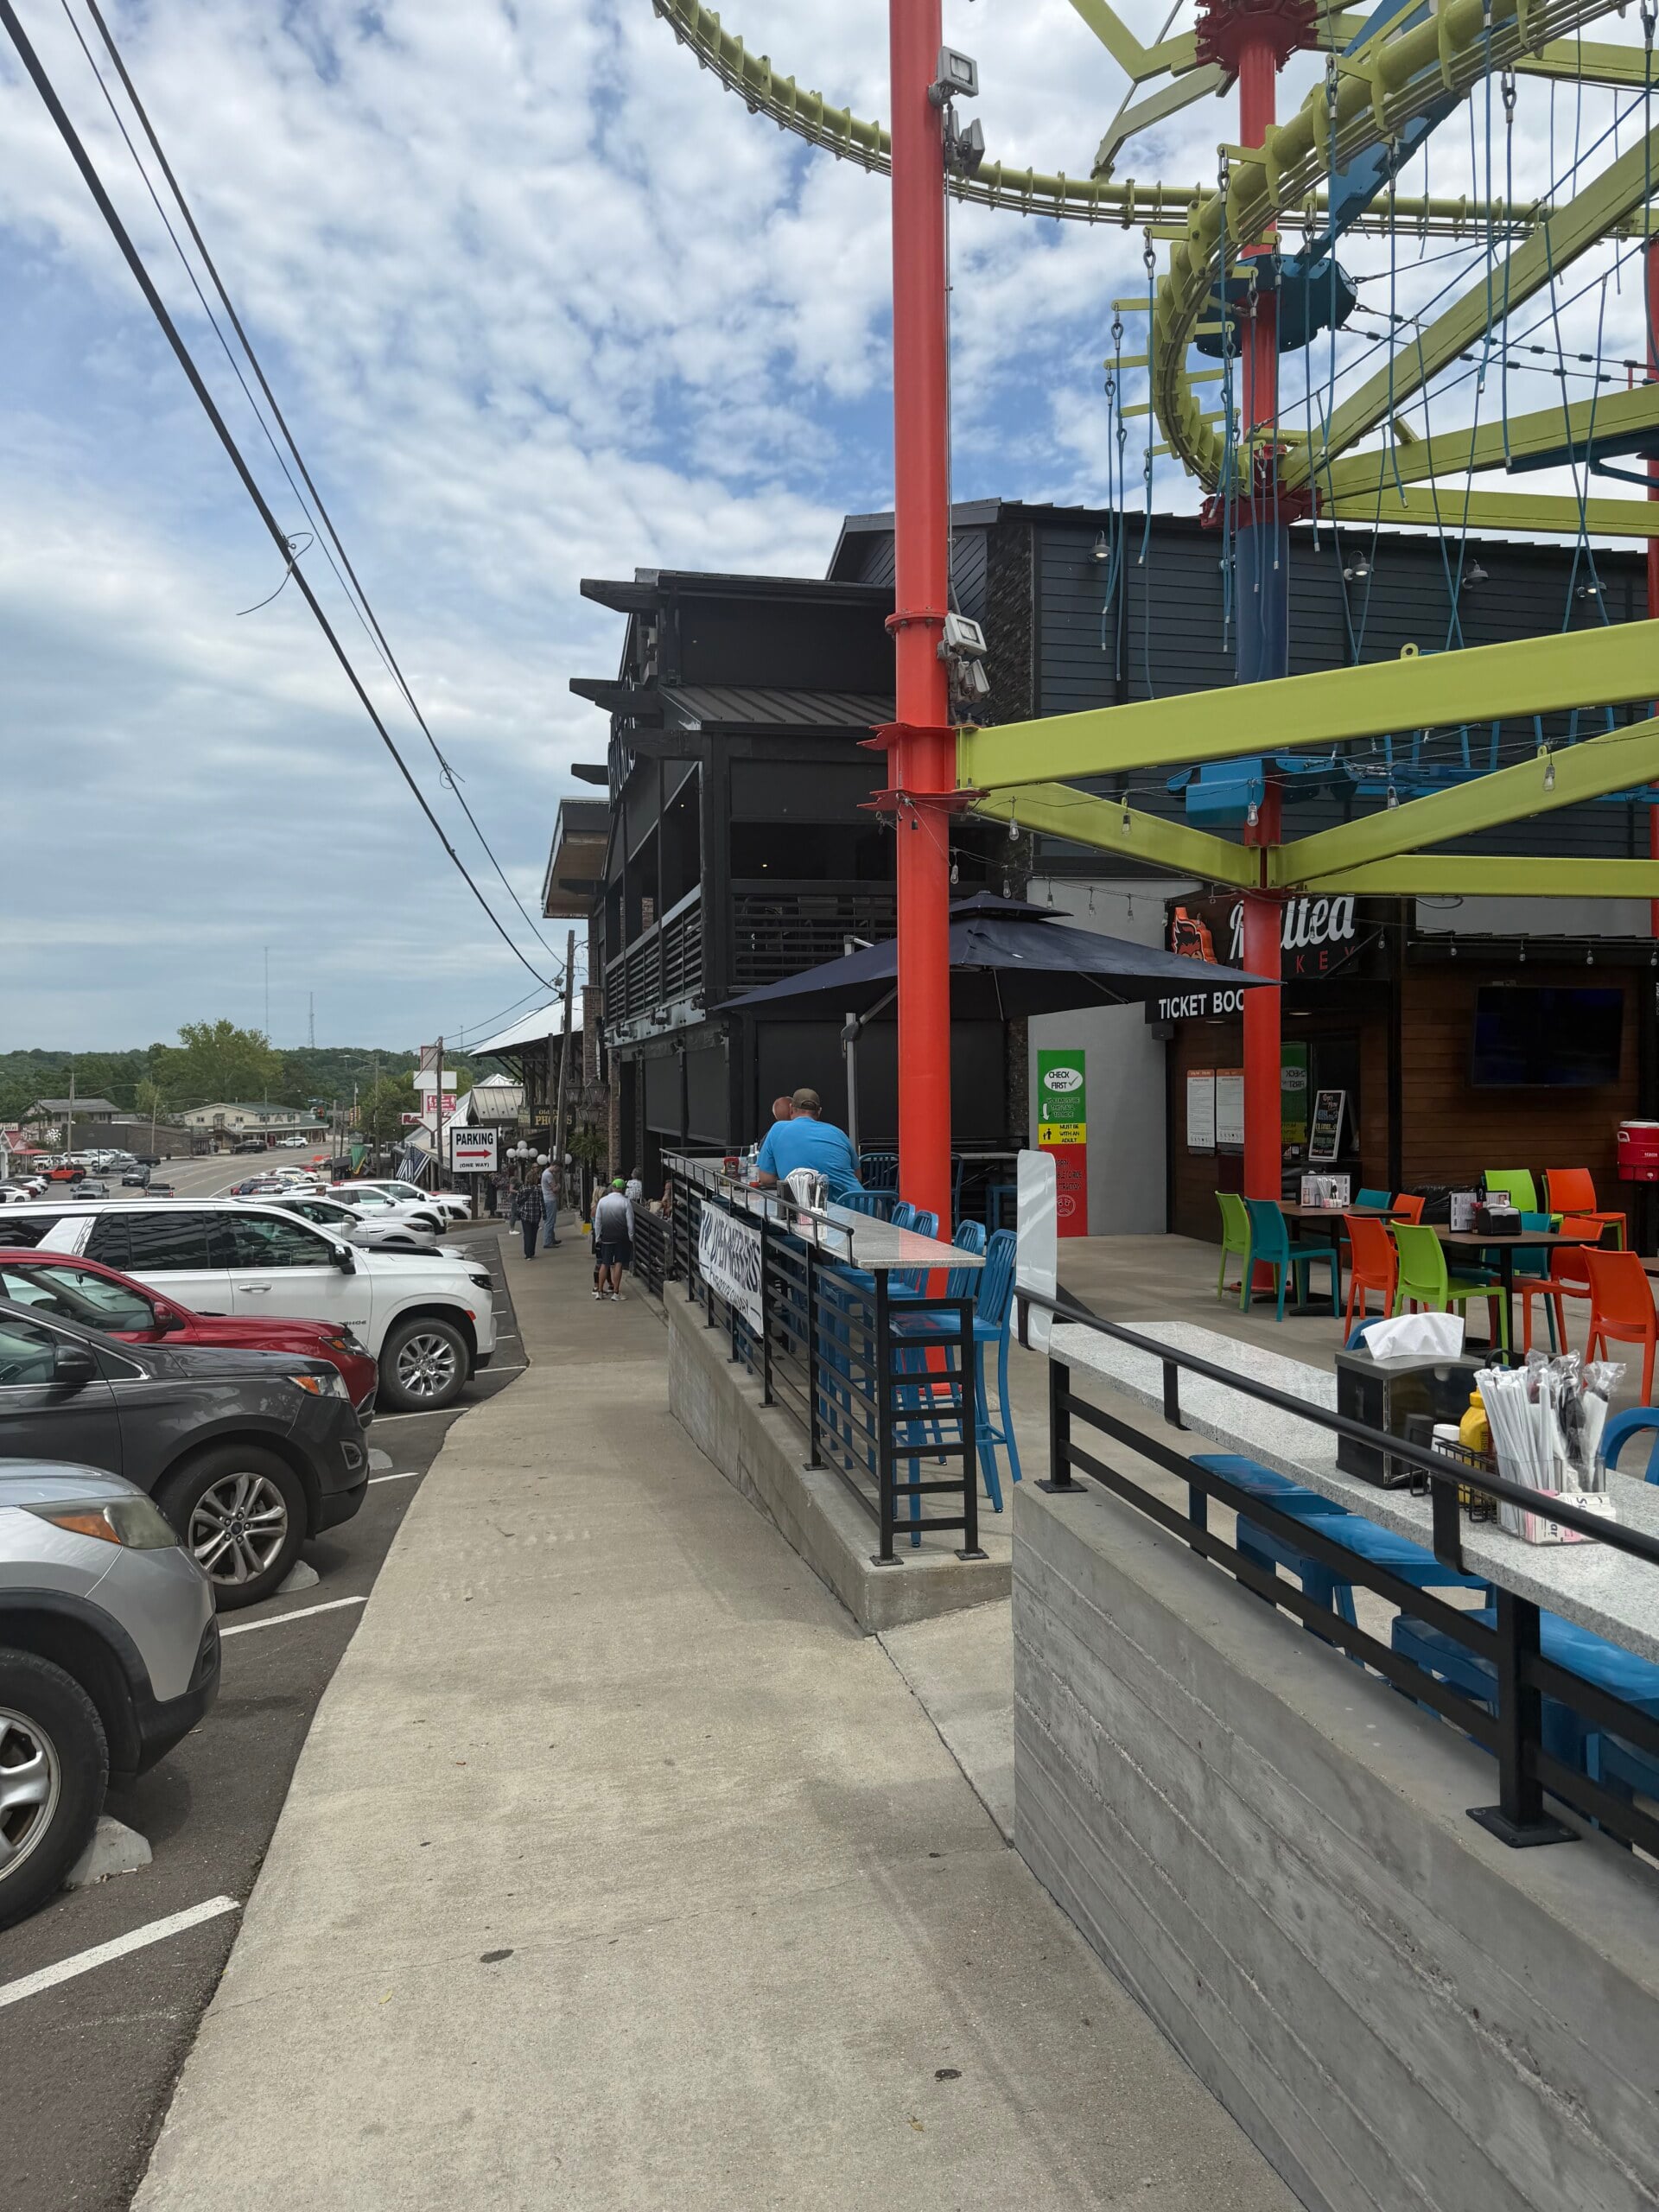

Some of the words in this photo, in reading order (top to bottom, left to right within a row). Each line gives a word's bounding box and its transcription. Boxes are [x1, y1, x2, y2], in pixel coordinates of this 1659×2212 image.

[1230, 896, 1356, 961] lted
[1158, 993, 1207, 1020] TICKET
[1212, 989, 1244, 1014] BOO
[535, 1115, 572, 1126] PHOTS
[455, 1133, 493, 1146] PARKING
